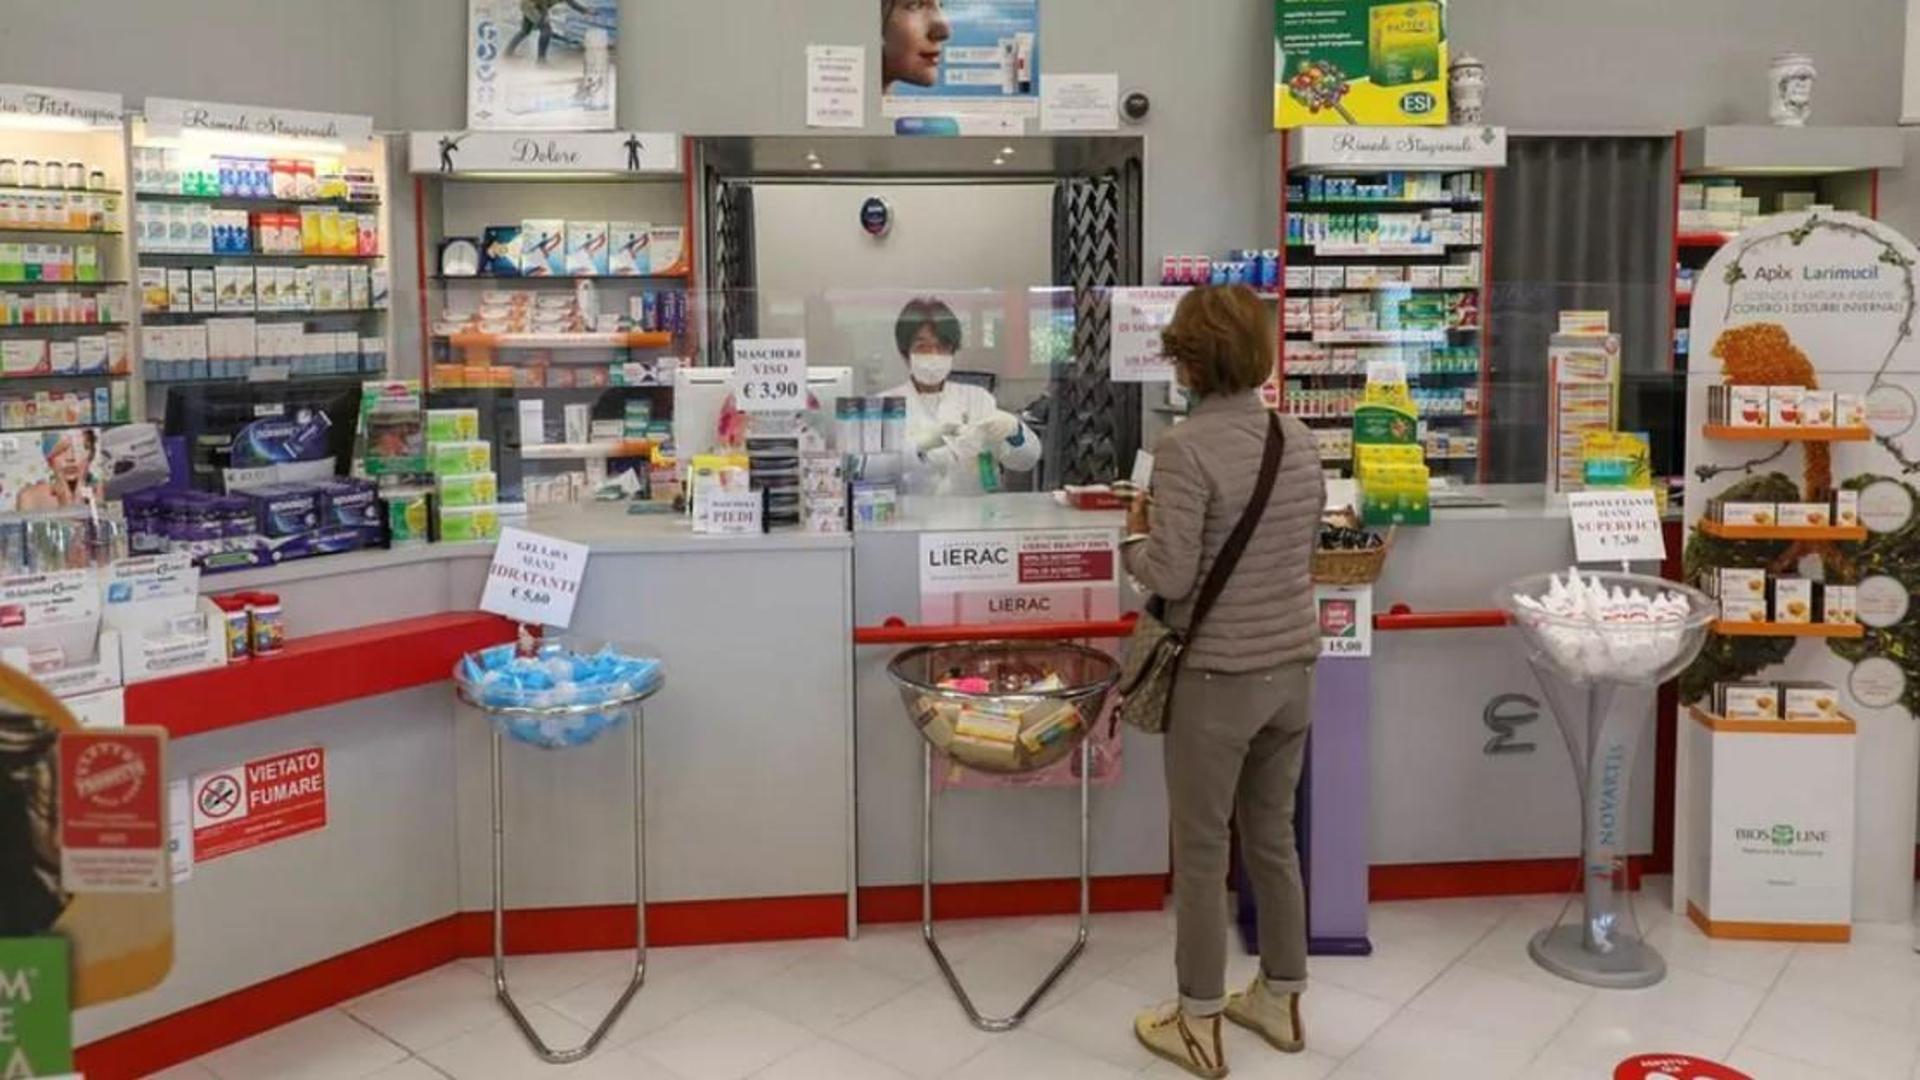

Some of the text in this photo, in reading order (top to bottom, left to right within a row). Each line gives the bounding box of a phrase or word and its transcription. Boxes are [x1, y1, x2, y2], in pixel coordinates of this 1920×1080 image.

[1404, 95, 1431, 111] ESI
[511, 138, 582, 163] Dolore
[1754, 264, 1879, 282] Apix Larimucil
[1732, 303, 1782, 313] CONTRO
[1792, 303, 1838, 313] DISTURBI
[752, 364, 788, 375] VISO
[743, 381, 798, 399] € 3,90
[929, 547, 1009, 566] LIERAC
[989, 597, 1050, 612] LIERAC
[249, 752, 320, 783] VIETATO
[250, 774, 323, 809] FUMARE
[1599, 744, 1623, 846] NOVARTIS
[1736, 828, 1830, 842] BIOS LINE
